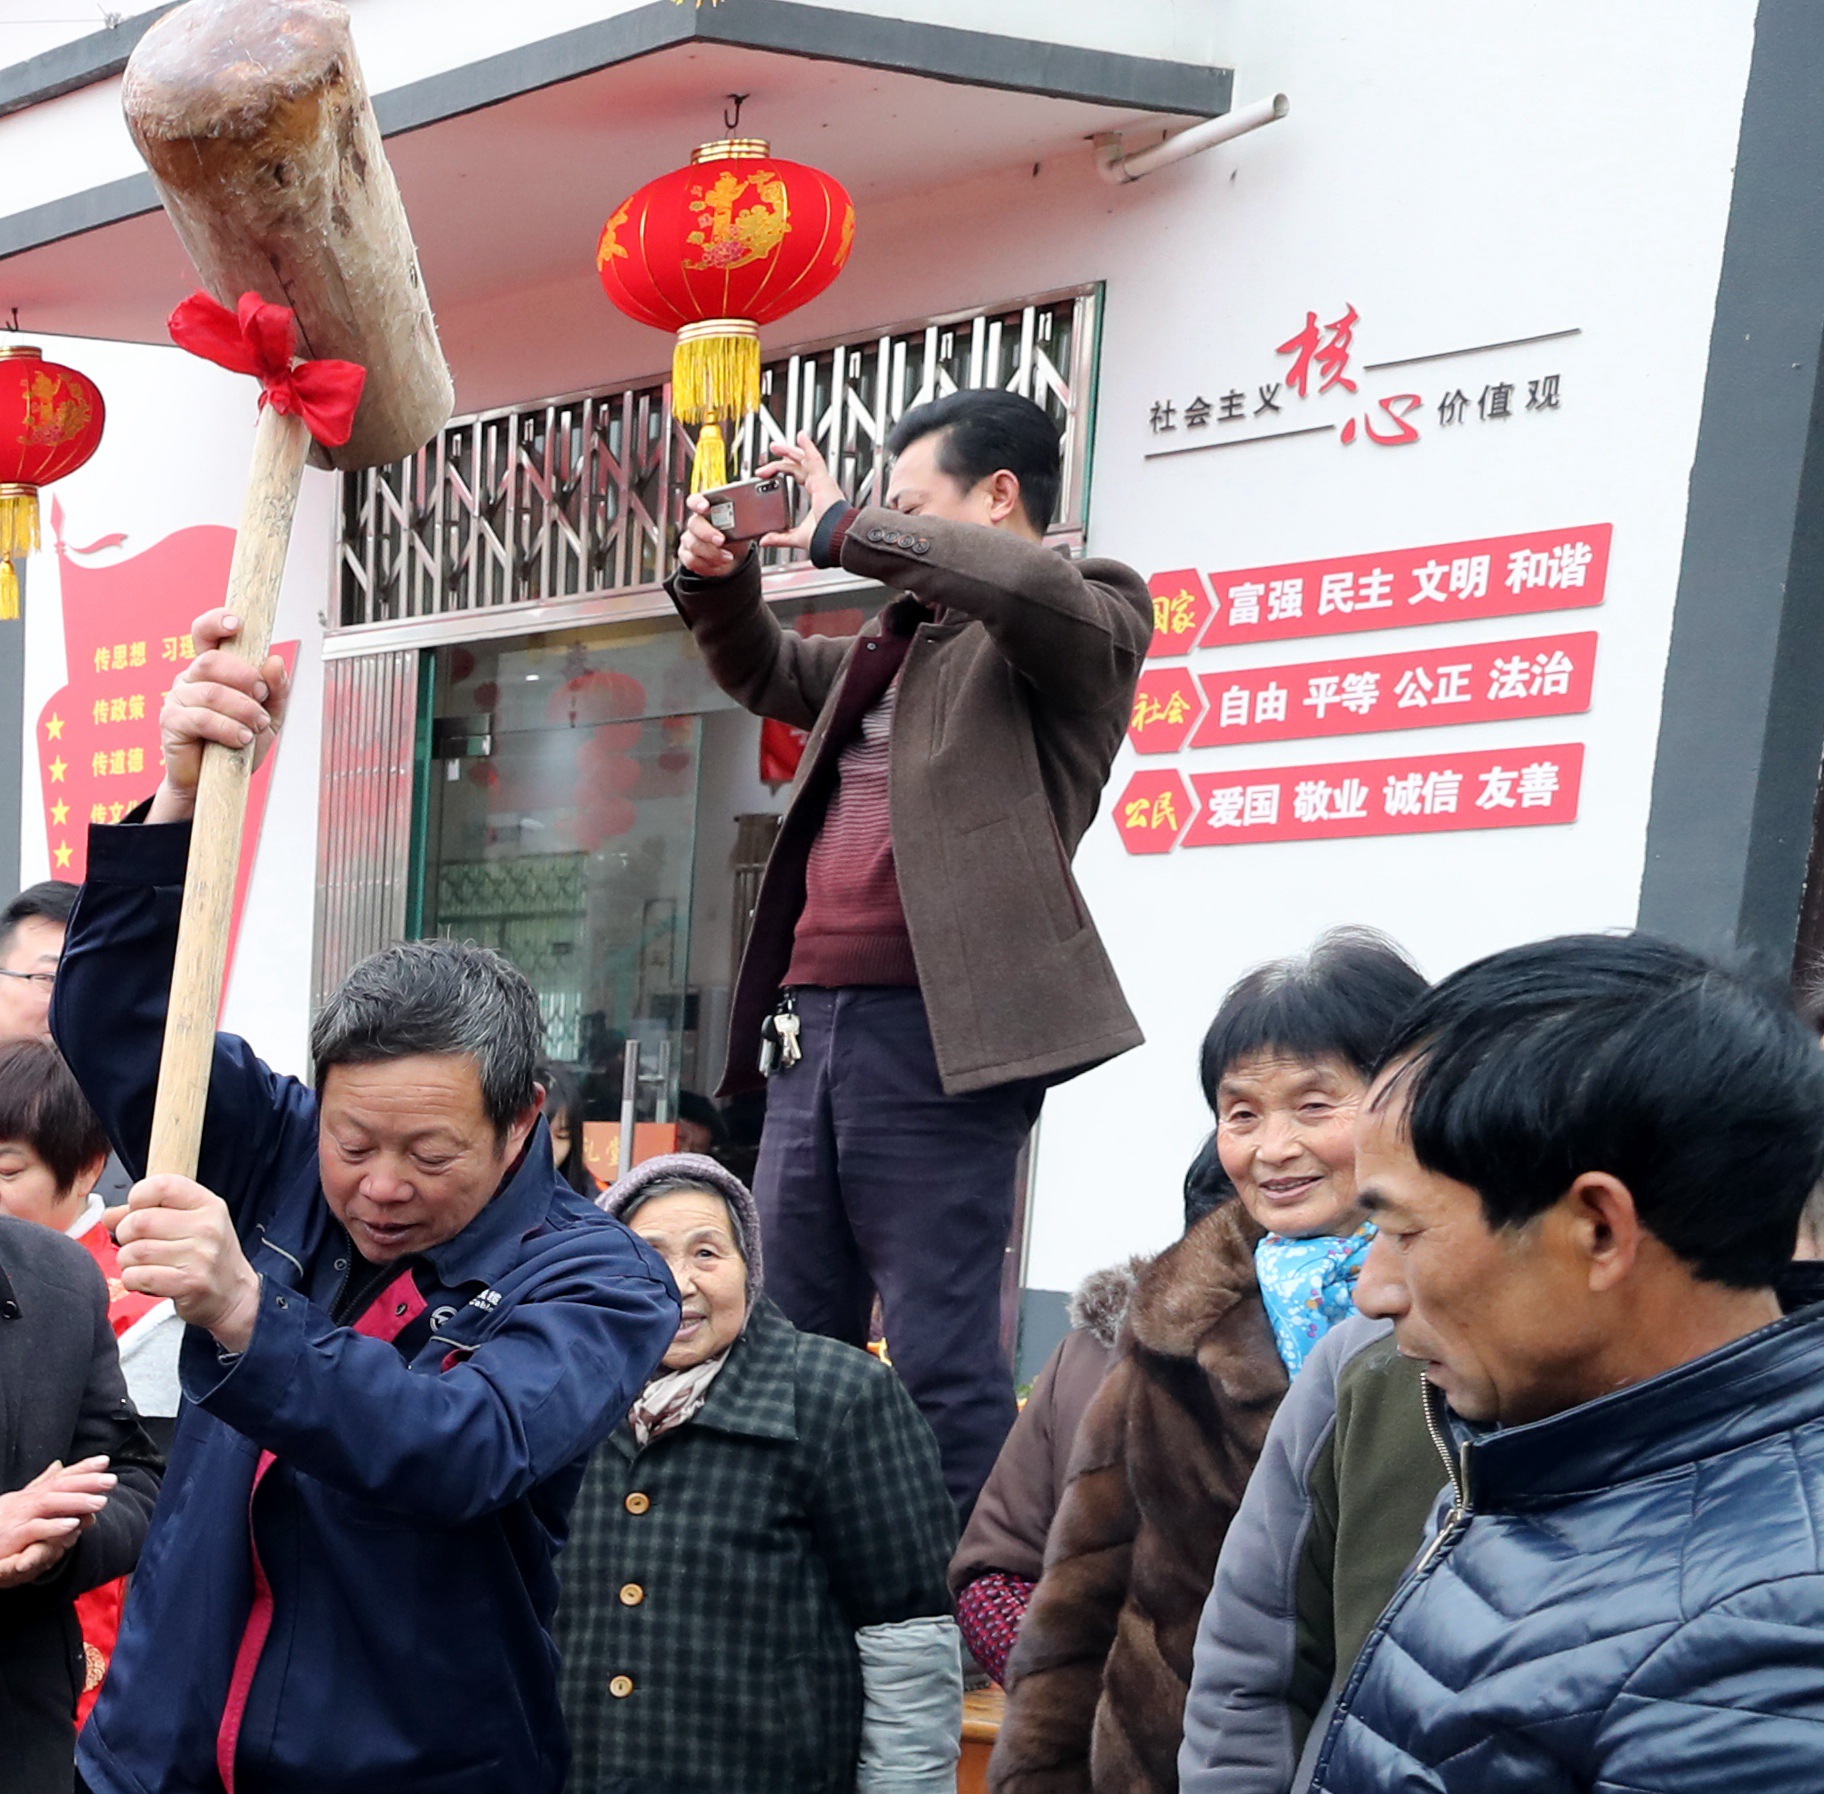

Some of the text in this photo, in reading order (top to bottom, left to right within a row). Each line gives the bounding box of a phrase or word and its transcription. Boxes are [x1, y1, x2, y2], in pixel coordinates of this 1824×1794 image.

[1149, 382, 1282, 434] 社会主义
[1437, 373, 1561, 426] 价值观
[1153, 541, 1594, 635] 国家 富强 民主 文明 和谐
[93, 633, 195, 674] 传思想 习理
[92, 694, 146, 726] 传政策
[1131, 650, 1574, 733] 社会 自由 平等 公正 法治
[91, 747, 145, 778] 传道德
[1124, 760, 1561, 832] 公民 爱国 敬业 诚信 友善
